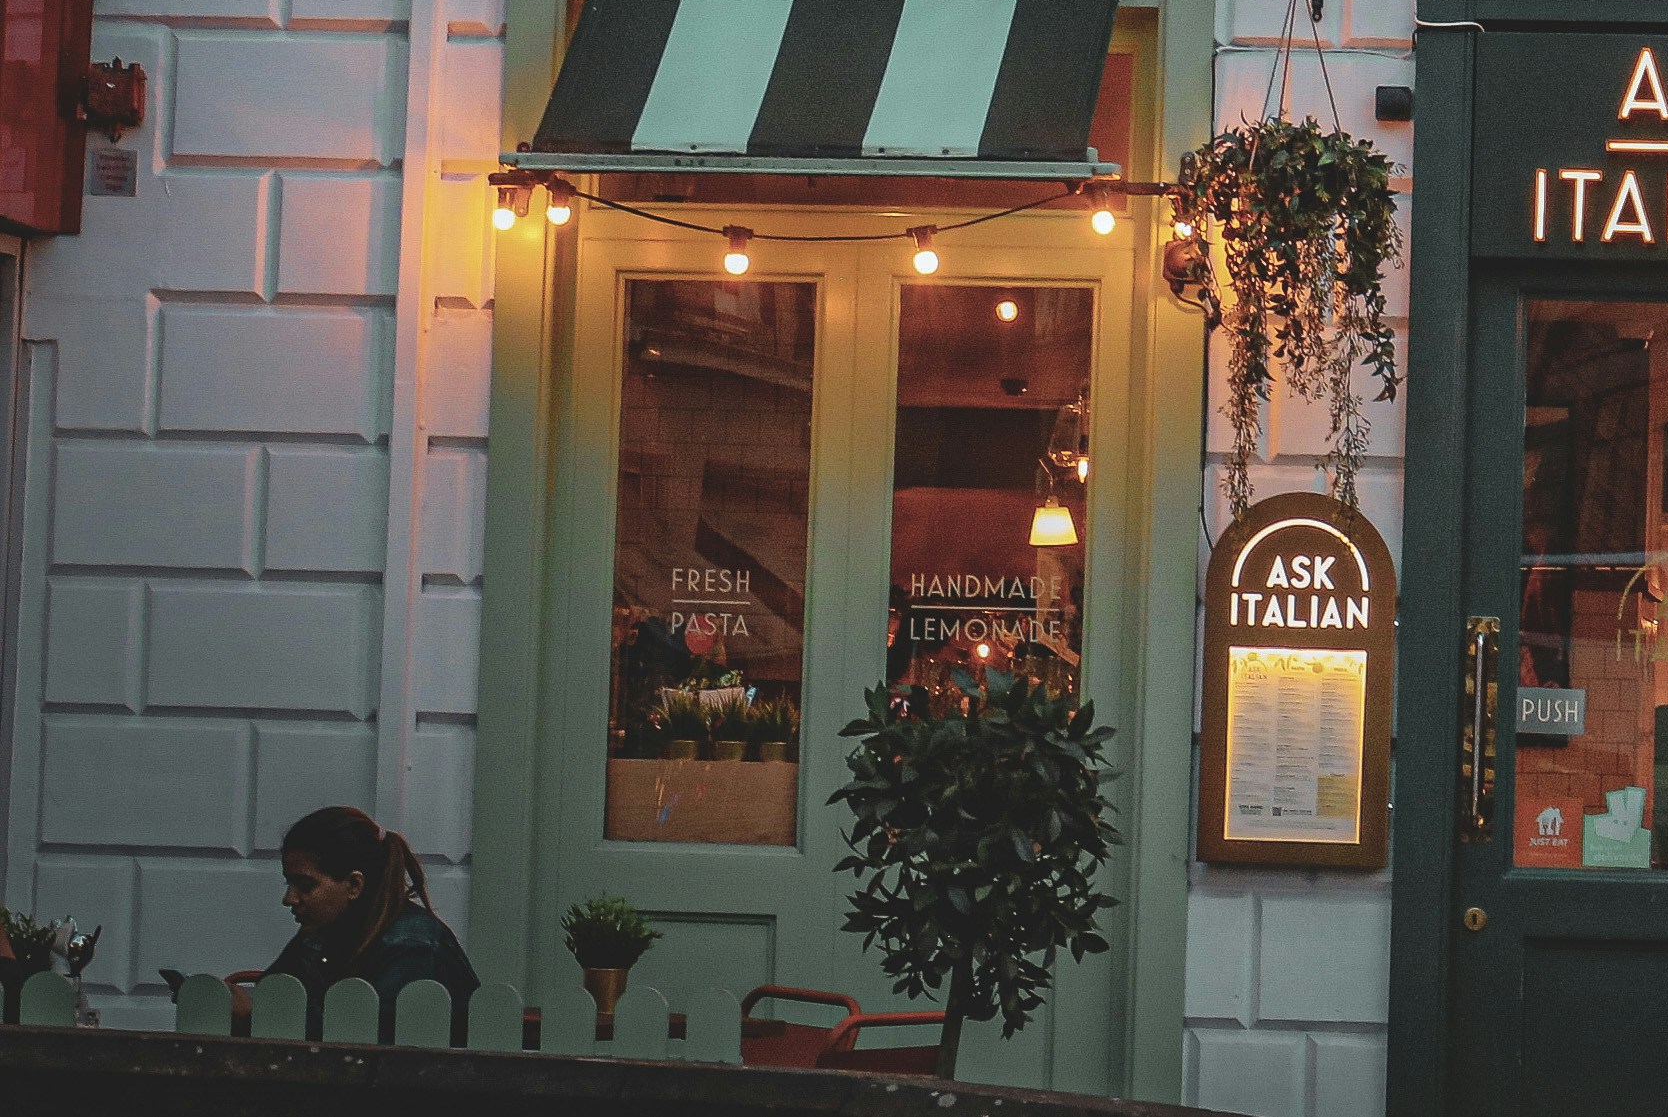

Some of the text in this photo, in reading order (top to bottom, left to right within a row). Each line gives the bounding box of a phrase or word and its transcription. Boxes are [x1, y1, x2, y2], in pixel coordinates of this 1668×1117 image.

[671, 567, 751, 594] FRESH
[1266, 555, 1336, 590] ASK
[911, 574, 1061, 601] HANDMADE
[1229, 591, 1369, 629] ITALIAN
[671, 612, 749, 638] PASTA
[910, 618, 1061, 643] LEMONADE
[1521, 698, 1579, 724] PUSH
[1529, 837, 1569, 847] JUST EAT
